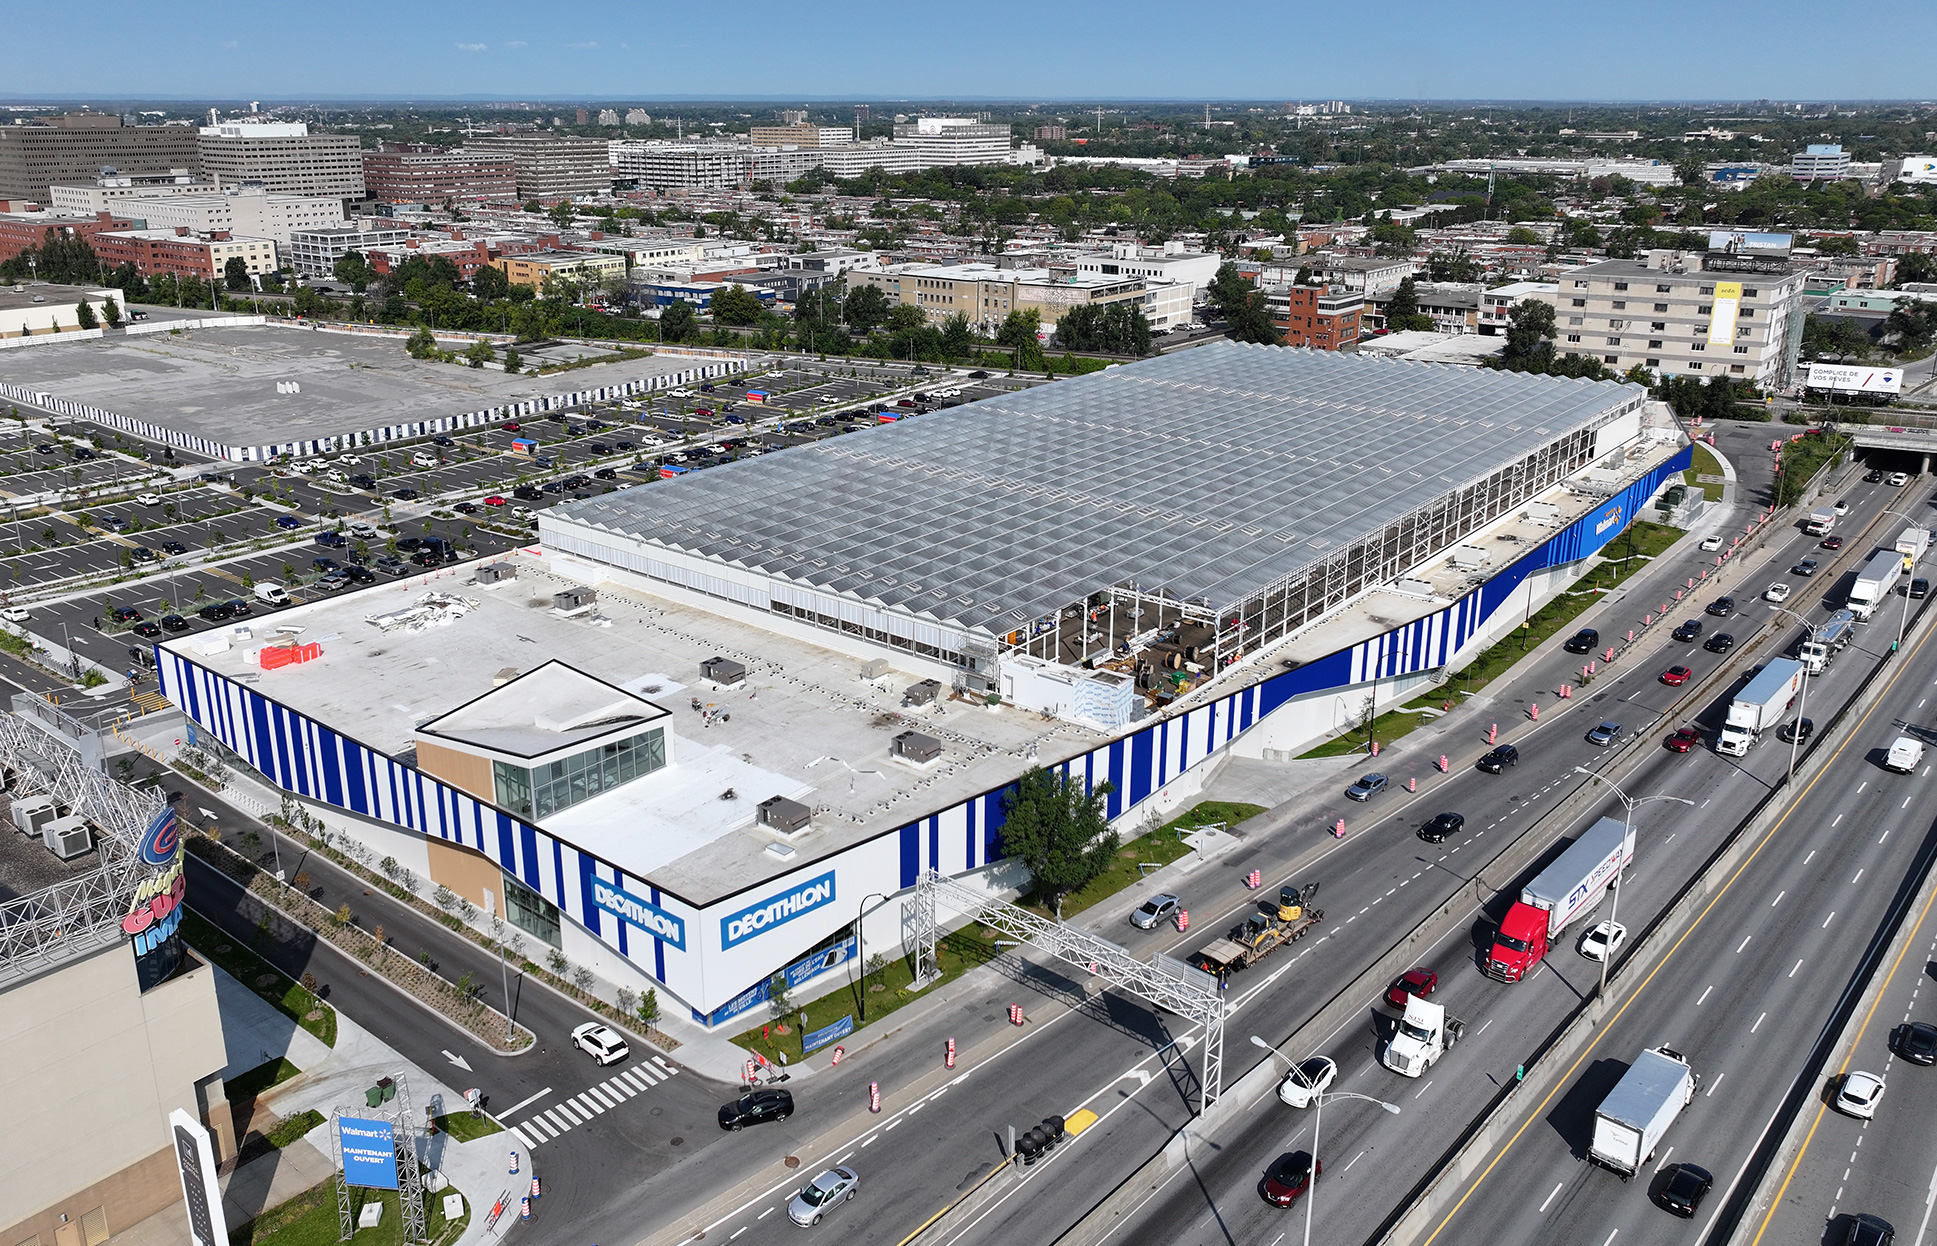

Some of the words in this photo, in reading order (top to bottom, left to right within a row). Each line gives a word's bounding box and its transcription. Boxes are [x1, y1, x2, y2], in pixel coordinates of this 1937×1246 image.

[1568, 879, 1589, 910] STX
[341, 1126, 378, 1138] Walmart
[343, 1147, 393, 1158] MAINTENANT
[353, 1155, 384, 1164] OUVERT
